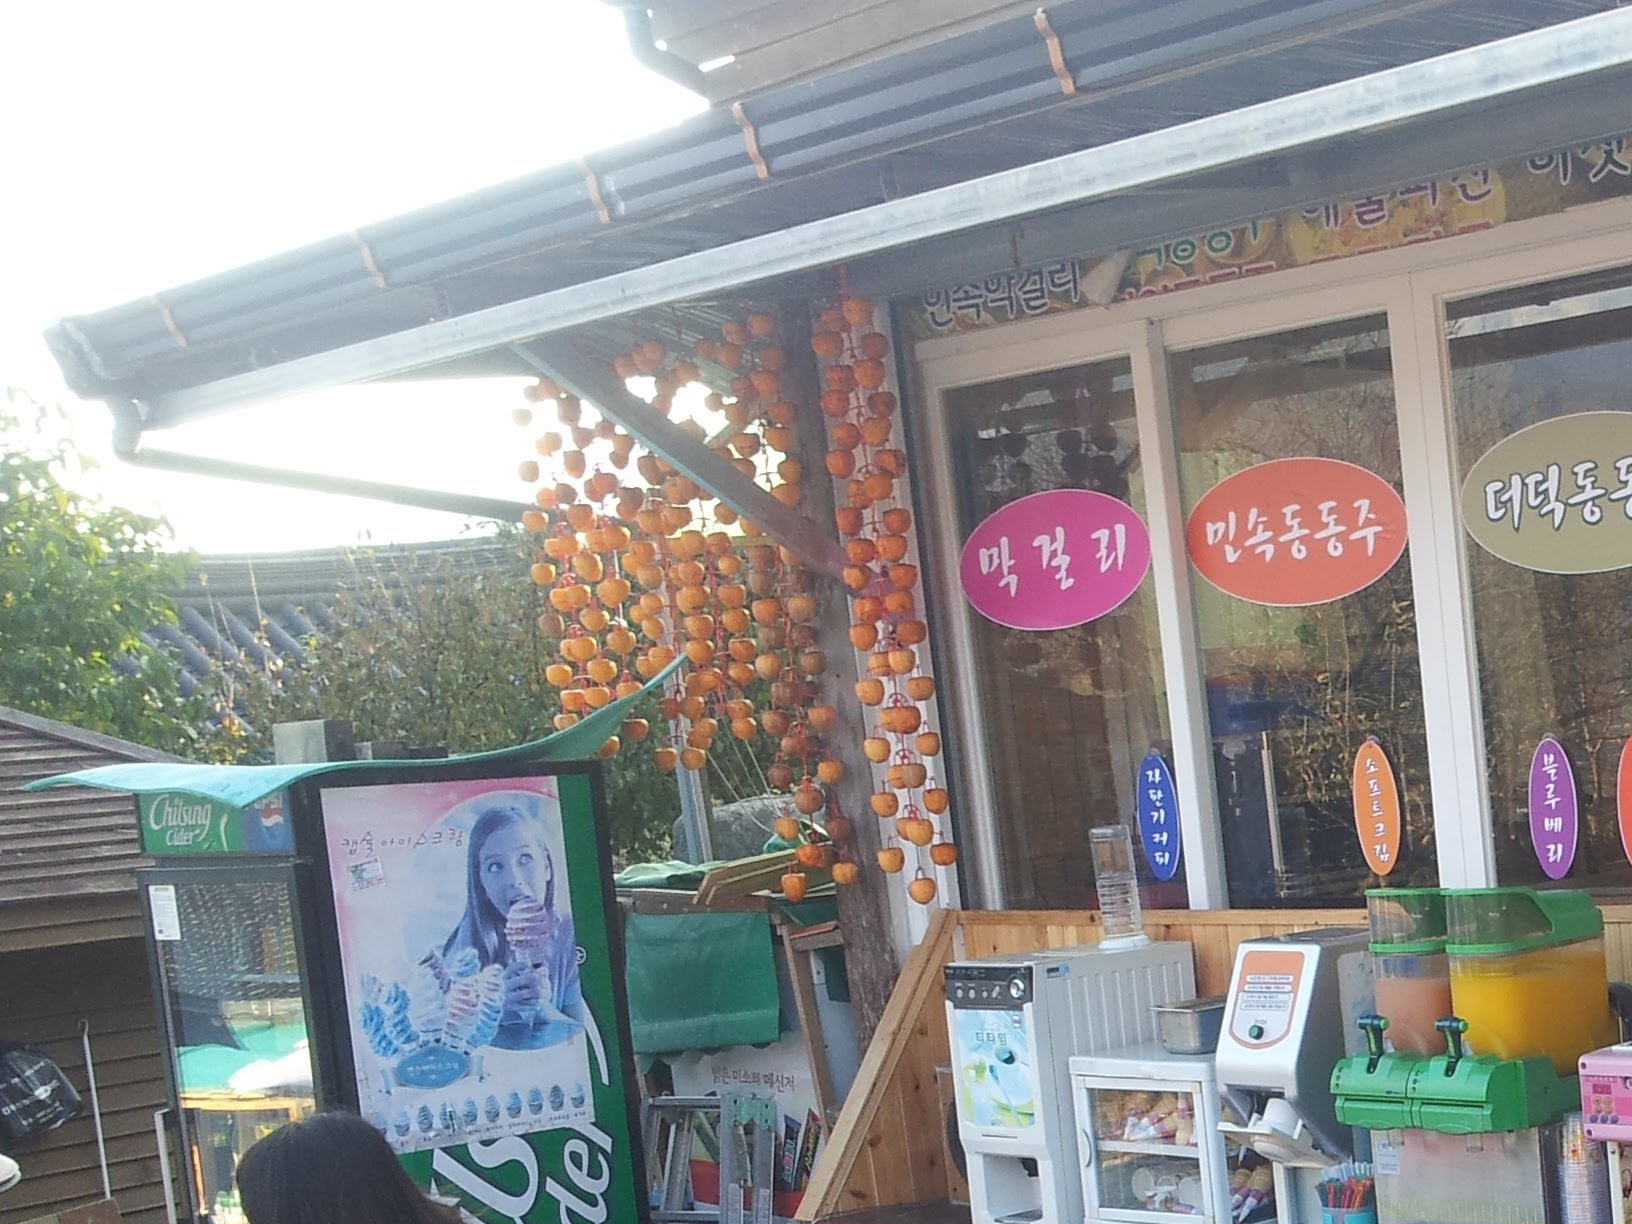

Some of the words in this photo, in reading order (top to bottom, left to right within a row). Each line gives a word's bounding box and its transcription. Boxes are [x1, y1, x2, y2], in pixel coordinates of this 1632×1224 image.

[978, 523, 1128, 598] 막걸리
[1206, 498, 1385, 565] 민속동동주
[151, 794, 212, 842] Chilsung
[166, 828, 201, 846] Cider
[1145, 769, 1171, 867] 자판기커피
[1542, 754, 1564, 864] 블루베리
